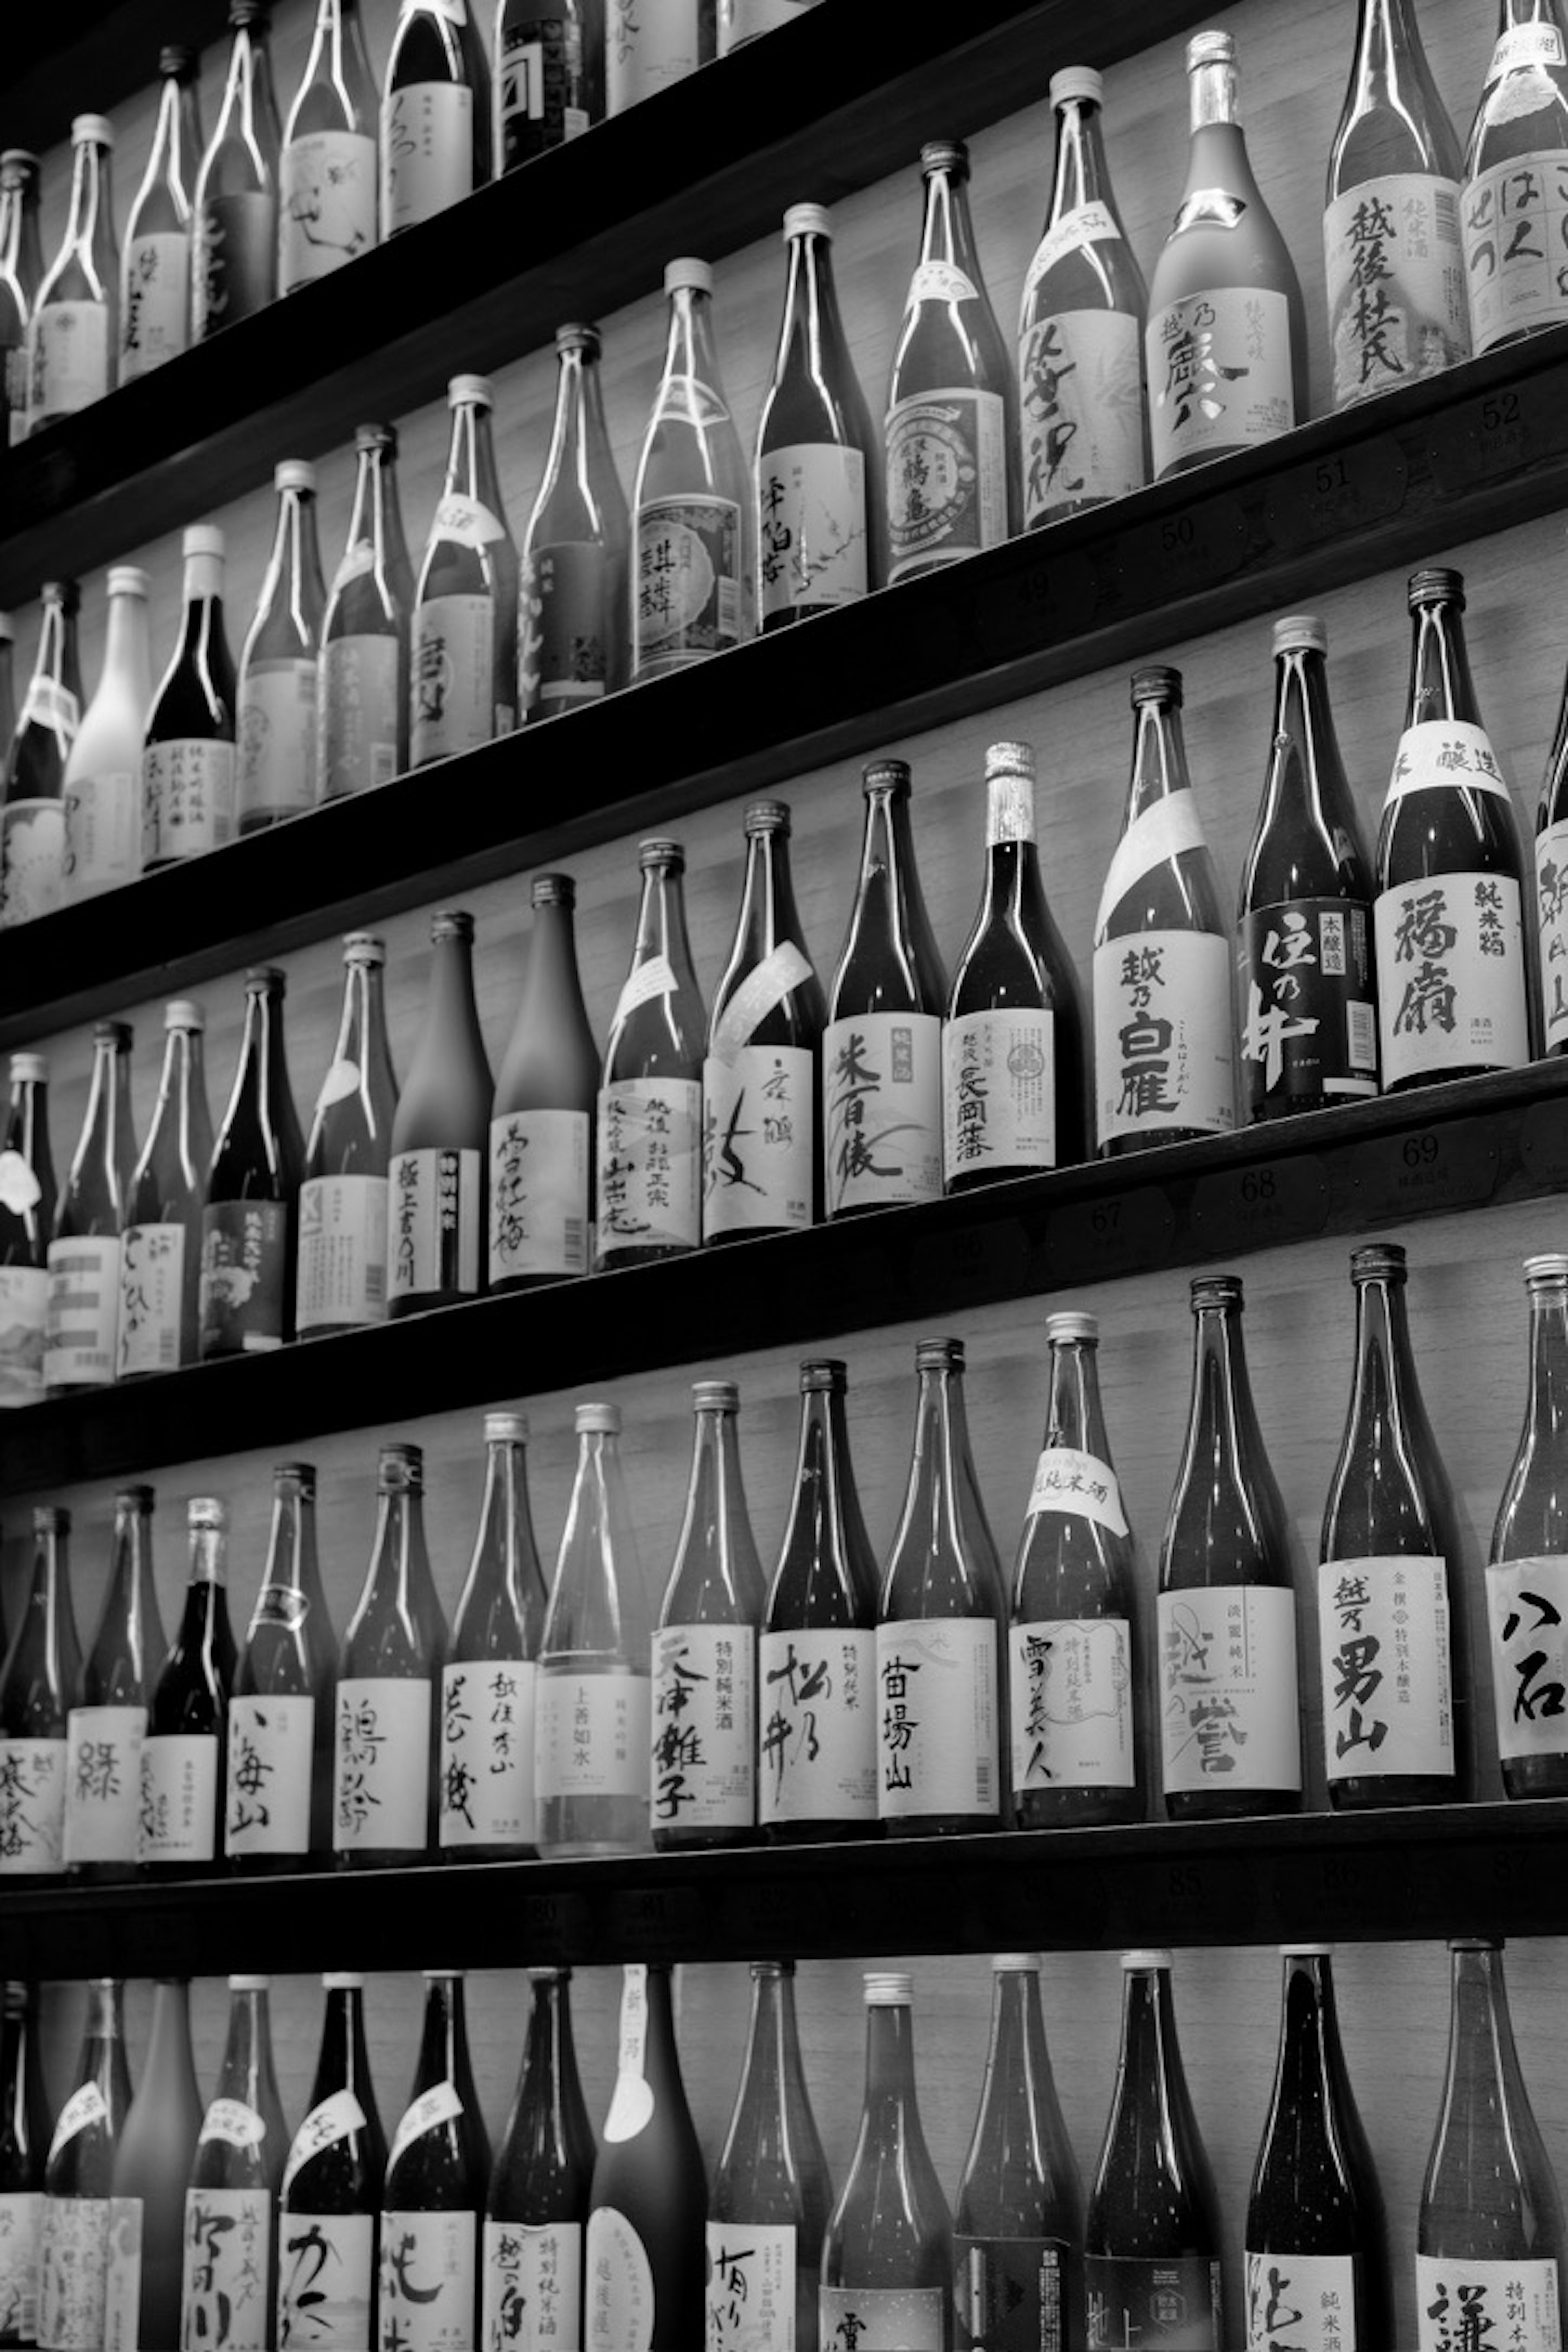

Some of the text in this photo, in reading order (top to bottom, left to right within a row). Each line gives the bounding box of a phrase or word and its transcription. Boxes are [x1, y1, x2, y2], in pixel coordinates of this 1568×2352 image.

[1402, 198, 1432, 260] 純米酒
[1345, 198, 1405, 385] 越後杜氏
[1484, 394, 1520, 430] 52
[1316, 457, 1351, 494] 51
[1161, 517, 1194, 551] 50
[1018, 571, 1049, 604] 49
[1322, 916, 1343, 971] 本醸造
[1474, 881, 1505, 957] 純米酒
[1116, 947, 1180, 1118] 越乃白雁
[833, 1033, 903, 1178] 米百俵
[1403, 1134, 1439, 1167] 69
[1241, 1170, 1276, 1200] 68
[1092, 1203, 1122, 1231] 67
[1332, 1576, 1388, 1759] 越乃男山
[1503, 1592, 1567, 1723] 八石
[572, 1686, 591, 1765] 上善如水
[883, 1657, 922, 1791] 苗場山
[1020, 1635, 1052, 1779] 雪美人
[1169, 1868, 1200, 1895] 85
[1323, 1859, 1360, 1889] 86
[1493, 1850, 1528, 1880] 87
